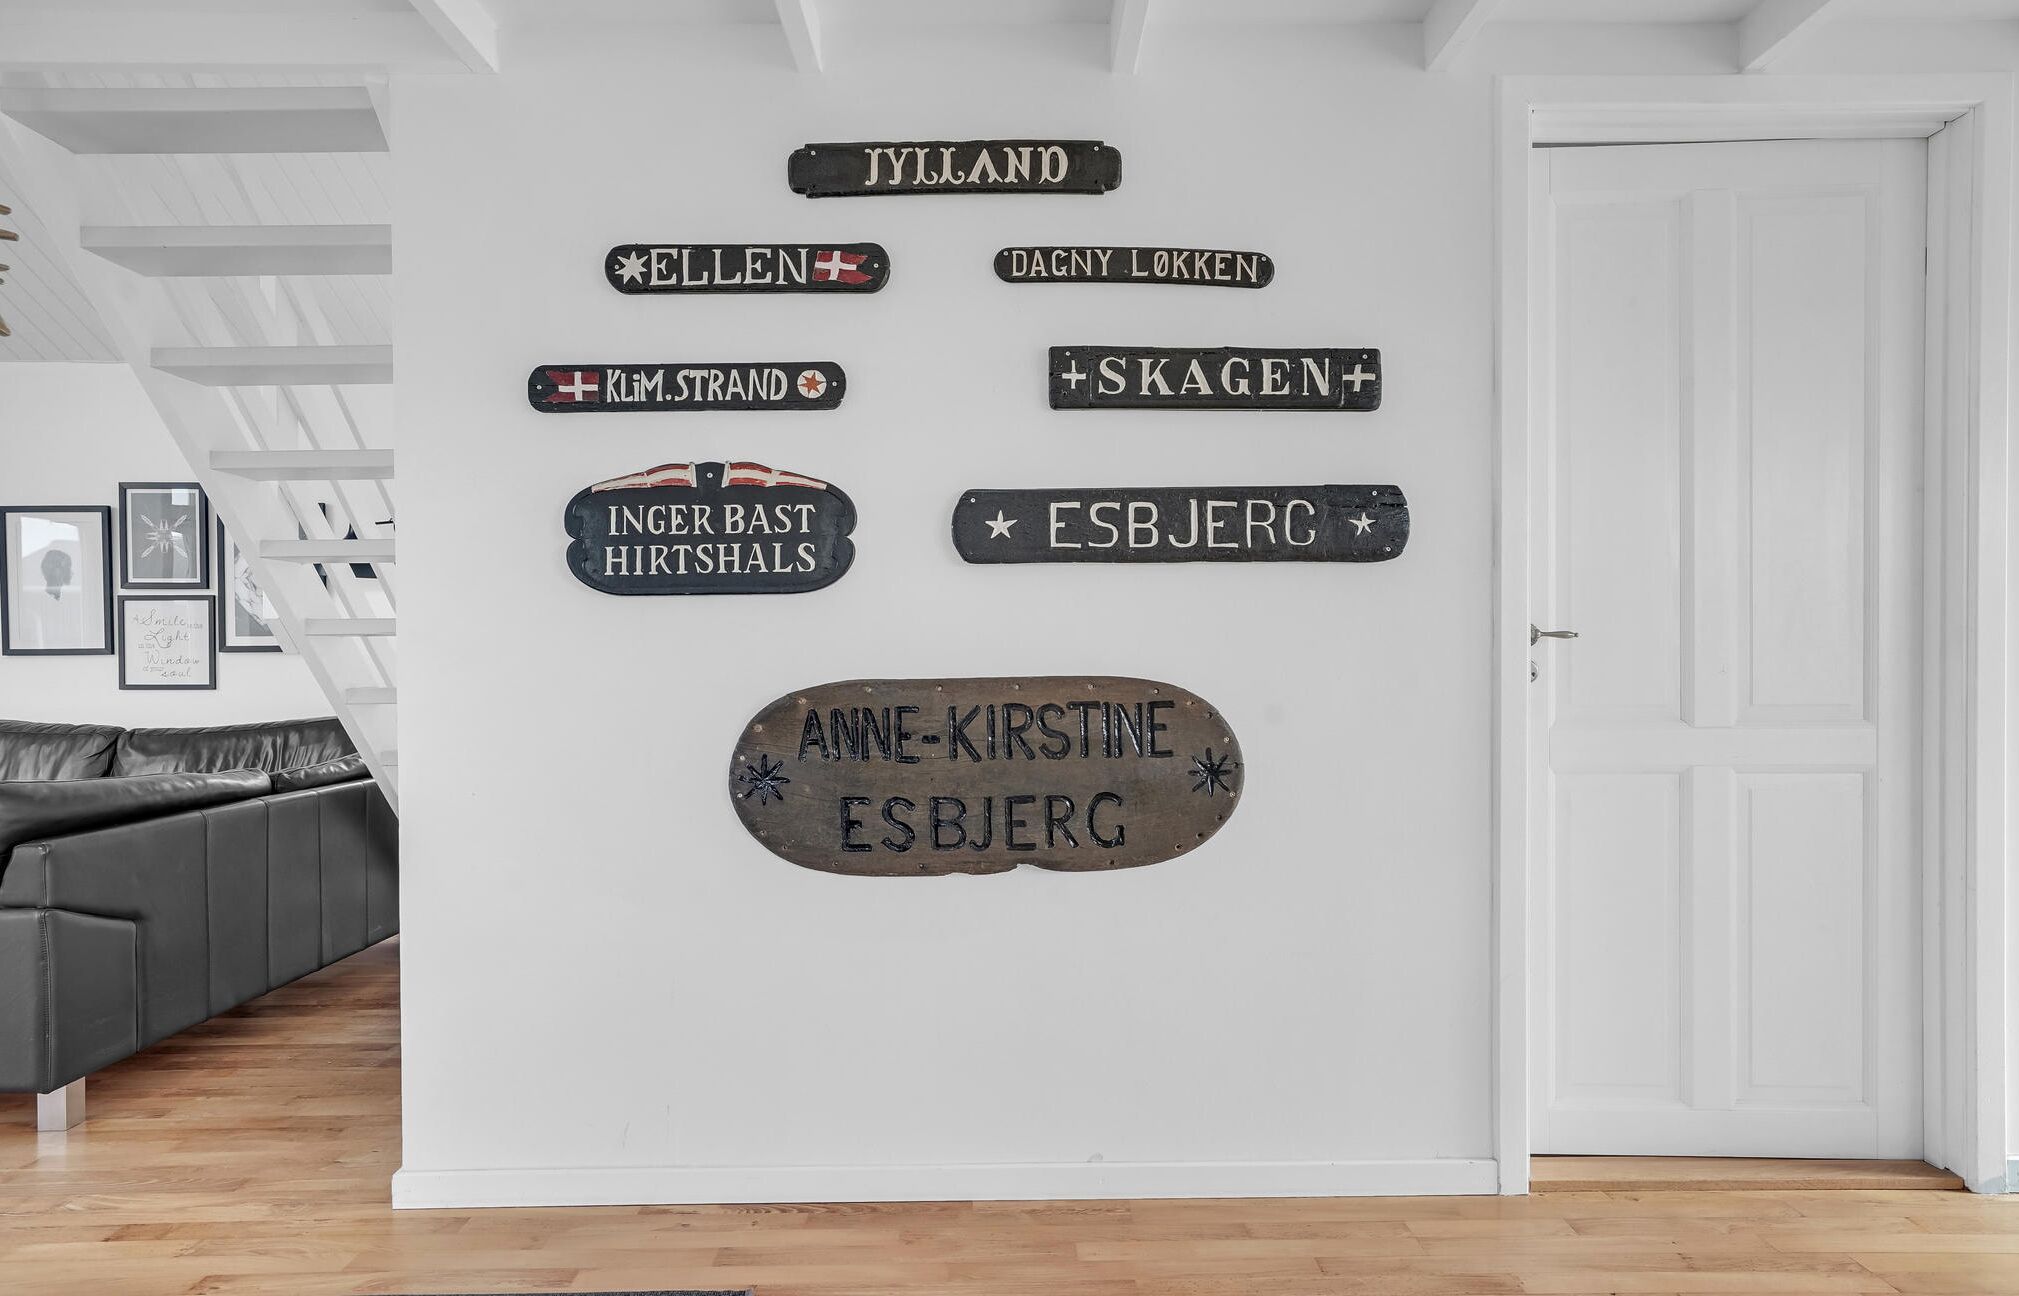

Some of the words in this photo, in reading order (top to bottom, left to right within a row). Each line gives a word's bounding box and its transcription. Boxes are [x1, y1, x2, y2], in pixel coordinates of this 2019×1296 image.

[864, 146, 1069, 186] JYLLAND
[649, 248, 809, 287] ELLEN
[1011, 249, 1114, 278] DAGNY
[1130, 250, 1259, 284] LØKKEN
[1097, 357, 1331, 397] SKAGEN
[607, 504, 715, 536] INGER
[724, 503, 816, 535] BAST
[604, 542, 816, 576] HIRTSHALS
[798, 701, 1175, 764] ANNE-KIRSTINE
[839, 791, 1126, 853] ESBJERG
